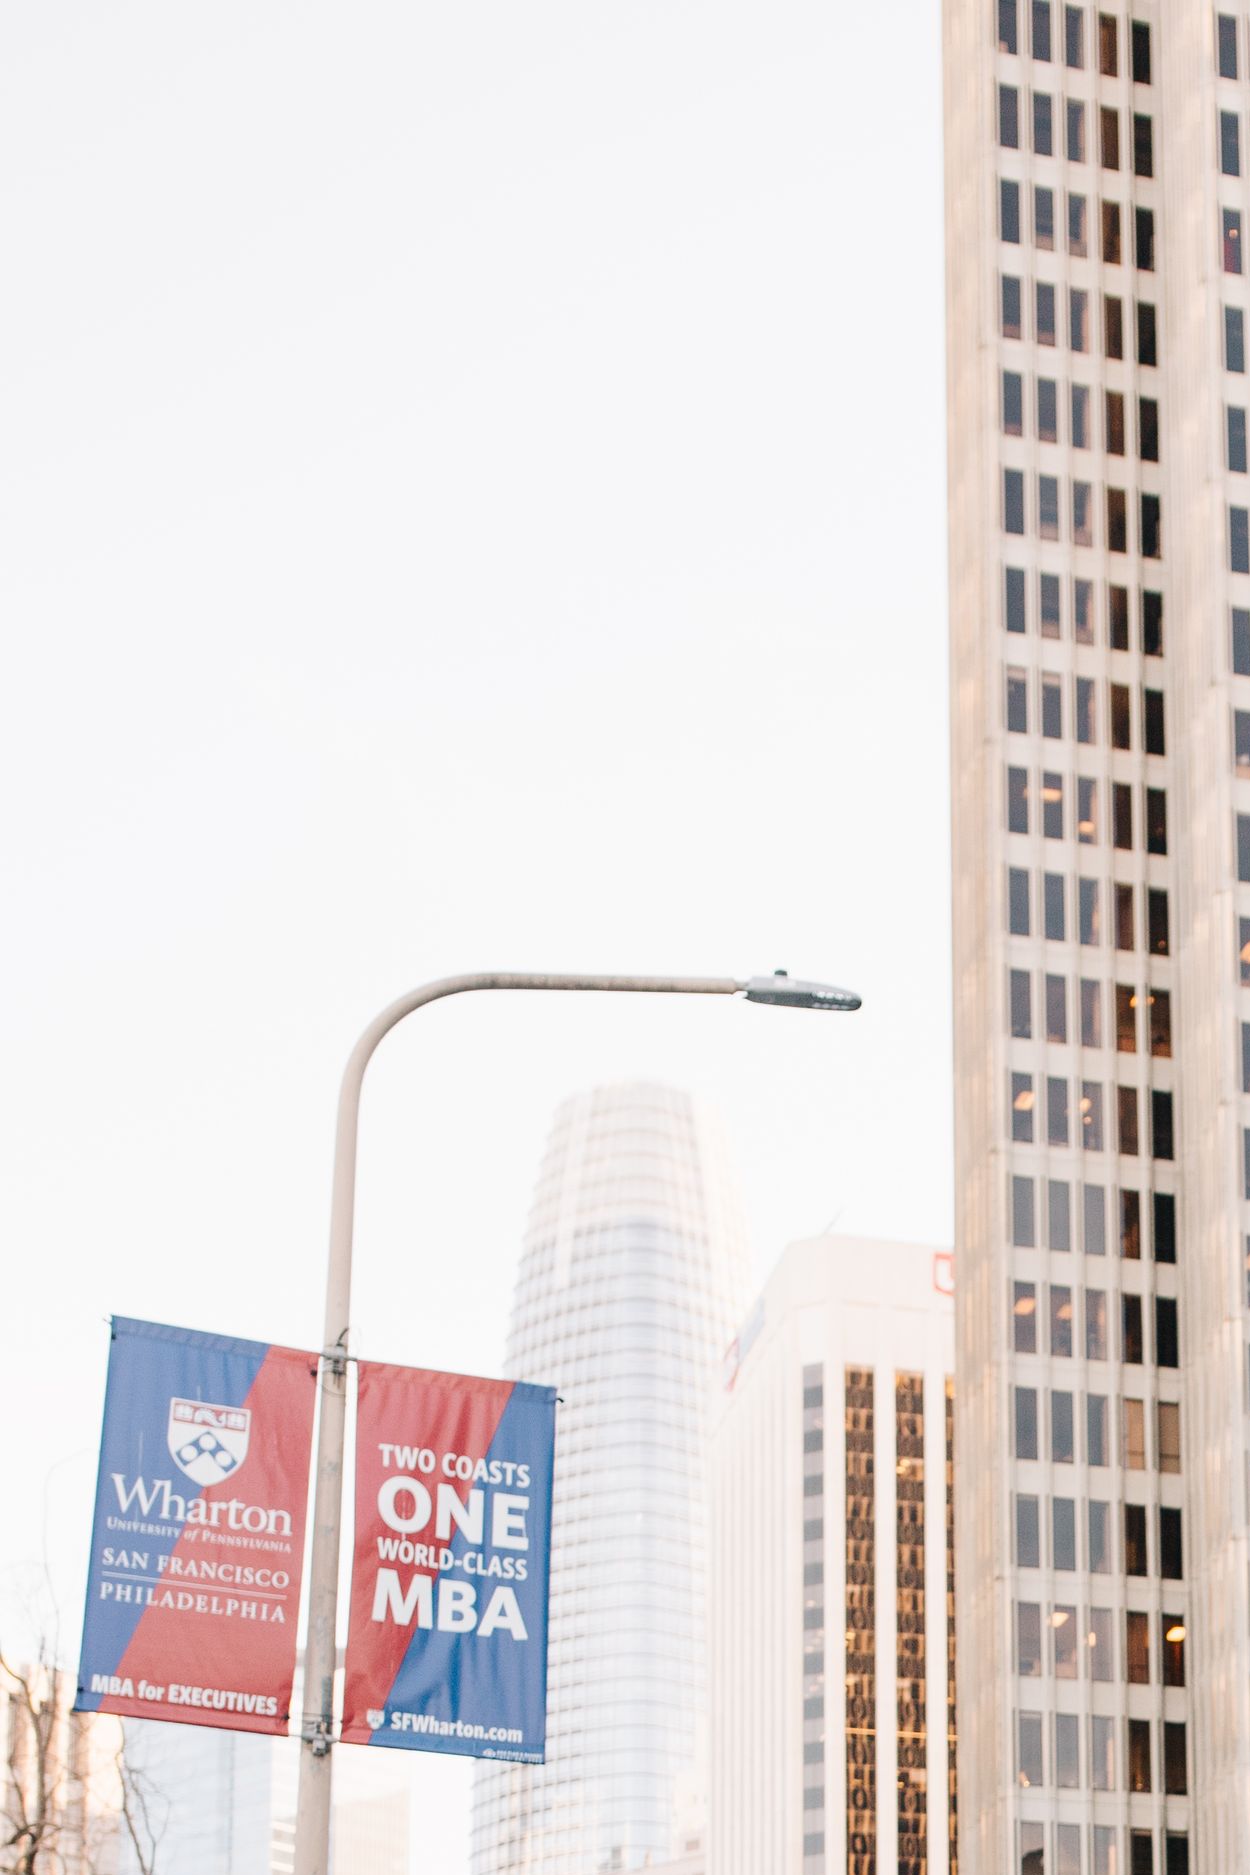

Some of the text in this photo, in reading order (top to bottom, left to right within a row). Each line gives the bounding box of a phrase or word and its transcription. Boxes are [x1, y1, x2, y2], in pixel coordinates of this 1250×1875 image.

[378, 1443, 530, 1488] TWO COASTS
[110, 1473, 292, 1536] Wharton
[377, 1475, 529, 1550] ONE
[107, 1517, 291, 1553] UNIVERSITY of PENNSYLVANIA
[102, 1547, 289, 1589] SAN FRANCISCO
[377, 1536, 528, 1580] WORLD-CLASS
[100, 1582, 285, 1623] PHILADELPHIA
[371, 1567, 528, 1640] MBA
[91, 1674, 277, 1715] MBA for EXECUTIVES
[391, 1711, 523, 1743] SFWharton.com
